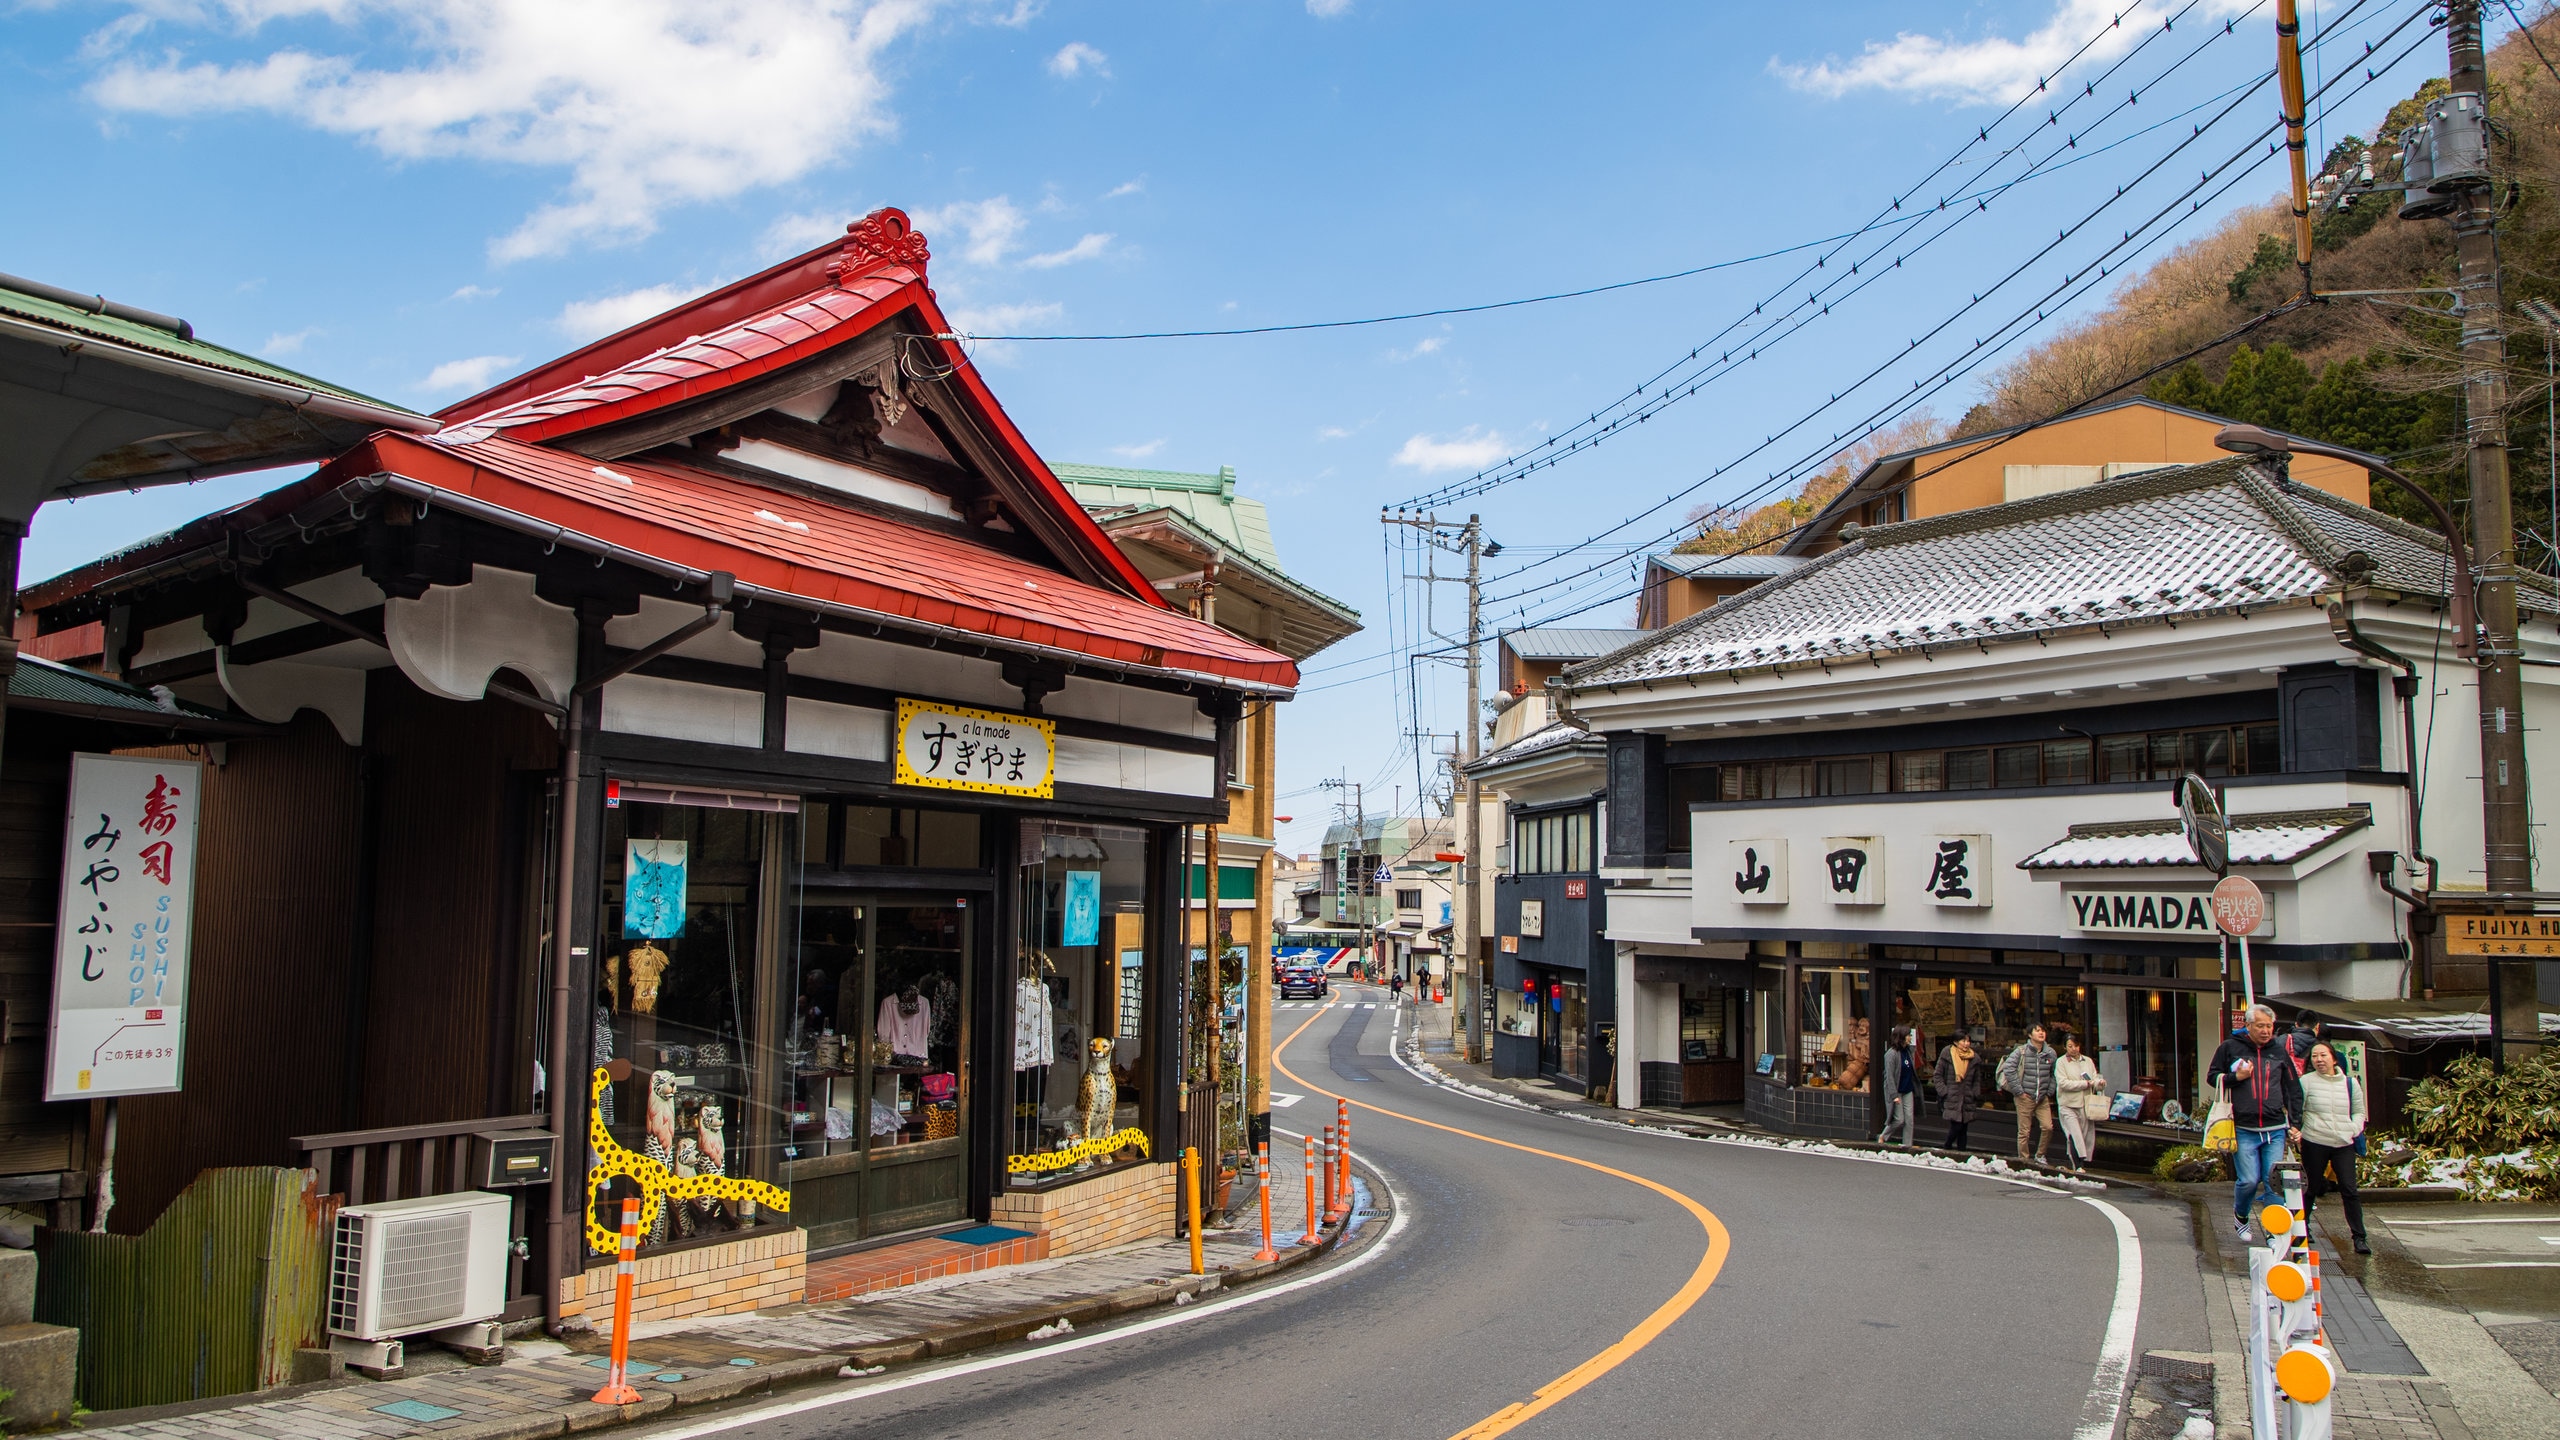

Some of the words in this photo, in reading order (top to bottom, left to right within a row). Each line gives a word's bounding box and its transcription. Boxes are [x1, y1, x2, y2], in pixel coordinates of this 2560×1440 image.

[922, 721, 1027, 781] すぎやま
[962, 723, 969, 734] a
[972, 720, 981, 736] la
[984, 724, 1011, 739] mode
[138, 774, 181, 886] 寿司
[78, 813, 121, 982] みやふじ
[1735, 839, 1972, 899] 山田屋
[2215, 895, 2259, 918] 消火栓
[2467, 919, 2530, 936] FUJIYA
[129, 922, 147, 1006] SHOP
[152, 895, 171, 998] SUSHI
[105, 1048, 174, 1061] この先徒歩3分
